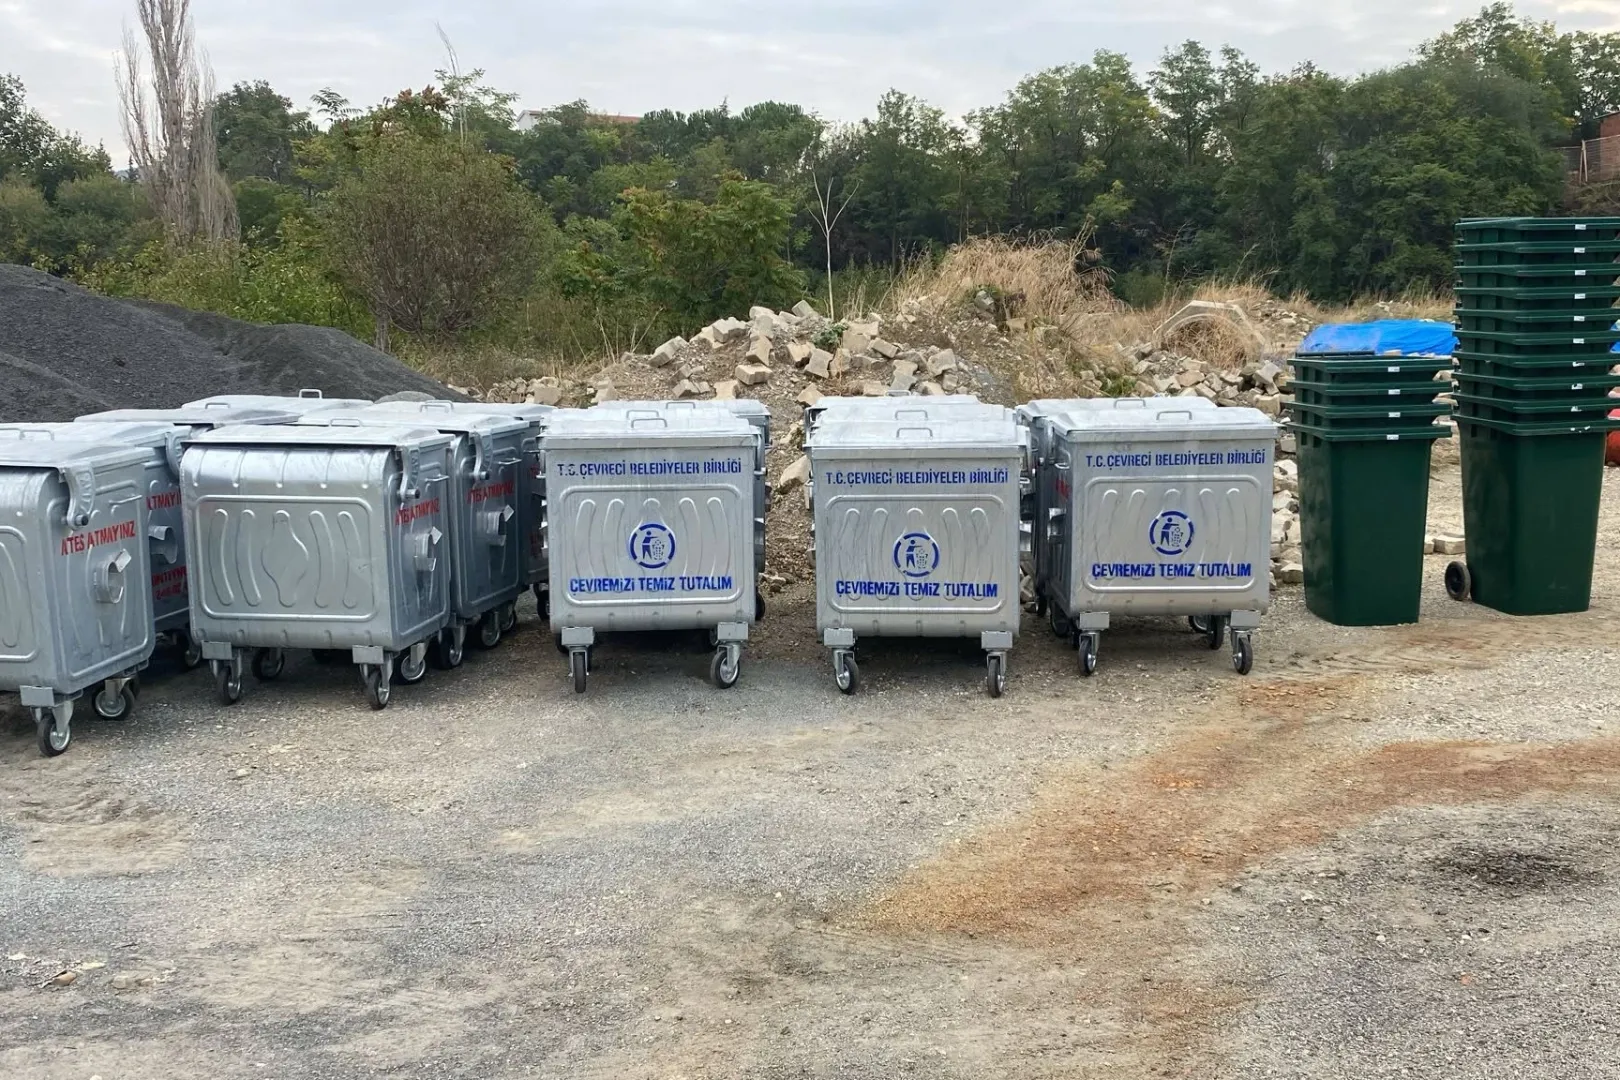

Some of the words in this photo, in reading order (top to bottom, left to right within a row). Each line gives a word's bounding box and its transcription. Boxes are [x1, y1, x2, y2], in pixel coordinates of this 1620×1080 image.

[1155, 451, 1224, 467] BELEDİYELER
[1227, 449, 1266, 464] BİRLİĞİ
[630, 459, 700, 476] BELEDİYELER
[703, 457, 742, 474] BİRLİĞİ
[896, 468, 966, 484] BELEDİYELER
[969, 467, 1009, 484] BİRLİĞİ
[1199, 562, 1252, 577] TUTALIM
[679, 575, 733, 591] TUTALIM
[944, 582, 999, 598] TUTALIM
